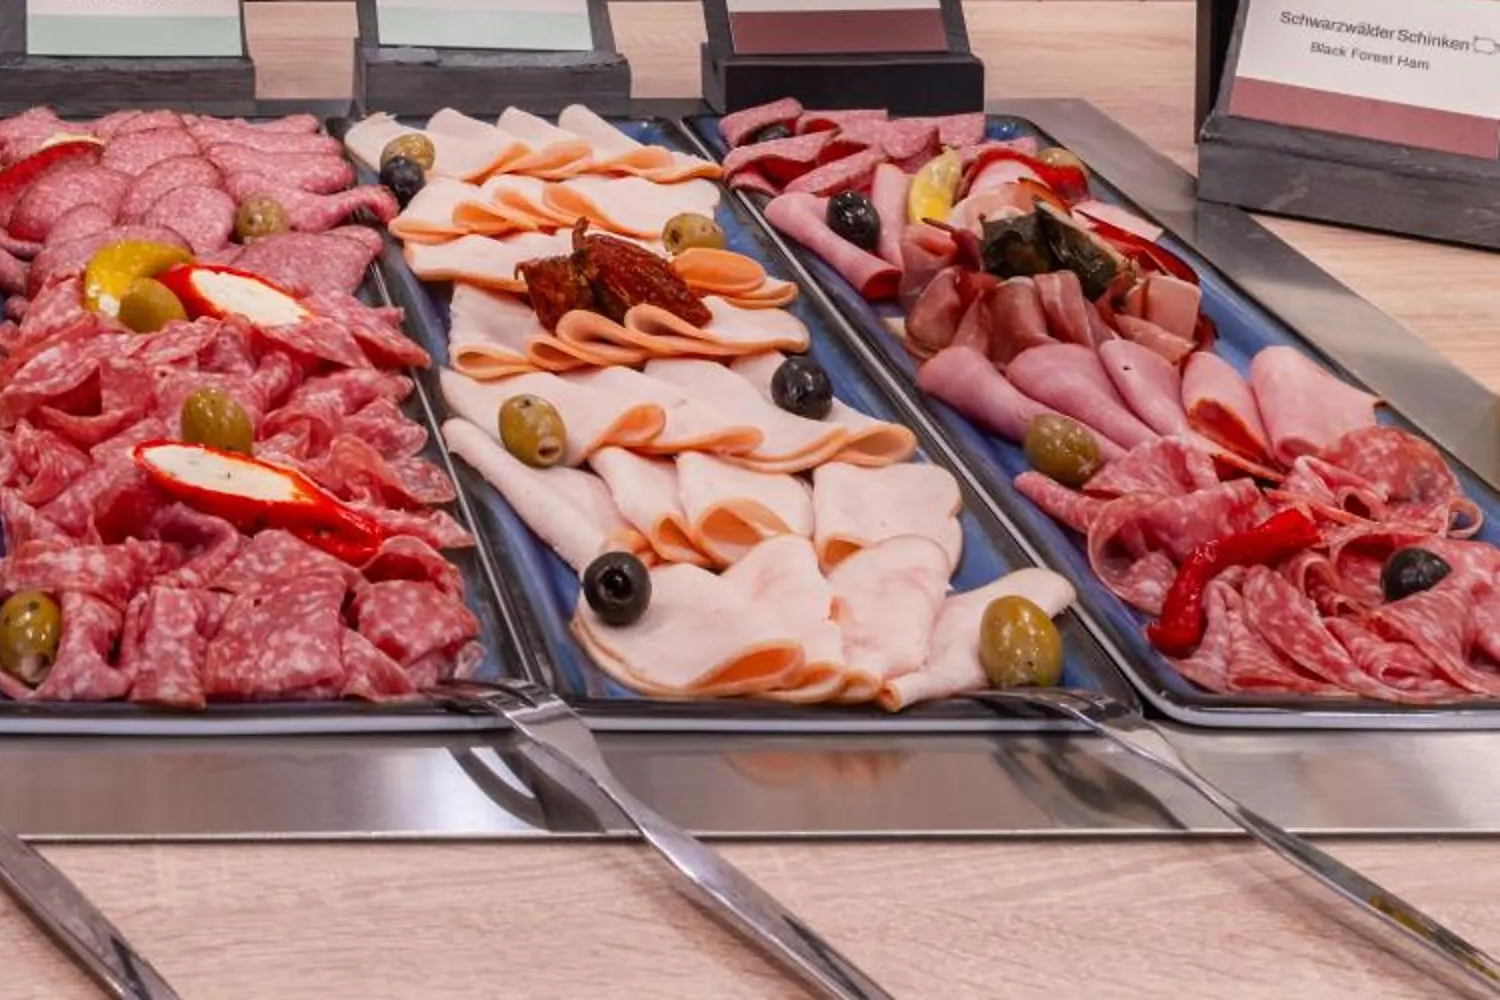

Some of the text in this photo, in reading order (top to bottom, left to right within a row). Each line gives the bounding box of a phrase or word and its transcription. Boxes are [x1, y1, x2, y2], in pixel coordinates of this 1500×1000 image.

[1280, 11, 1470, 51] Schwarzwälder Schinken
[1310, 41, 1430, 70] Black Forest Ham
